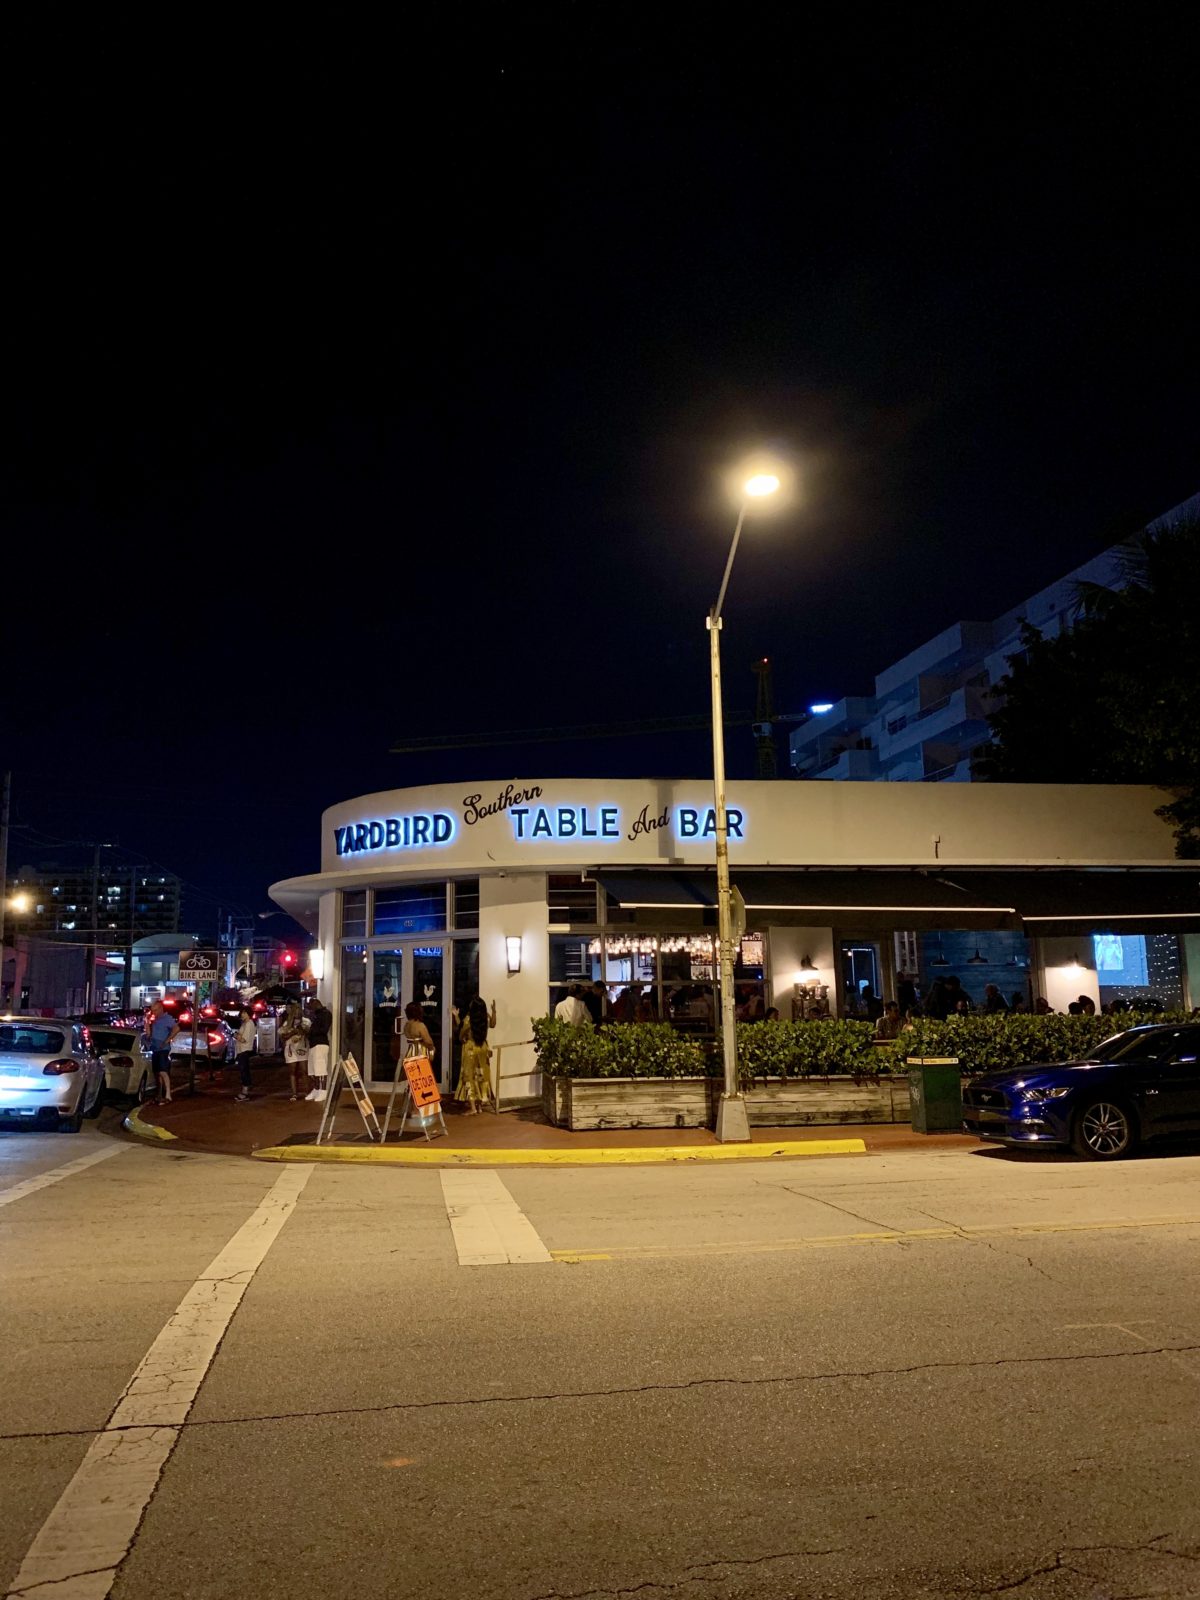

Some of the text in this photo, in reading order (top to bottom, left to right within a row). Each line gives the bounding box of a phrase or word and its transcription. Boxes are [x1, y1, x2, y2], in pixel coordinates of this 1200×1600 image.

[334, 784, 743, 855] YARDBIRD Southern TABLE And BAR
[180, 971, 216, 979] BIKE LANE
[411, 1075, 436, 1091] DETOUR
